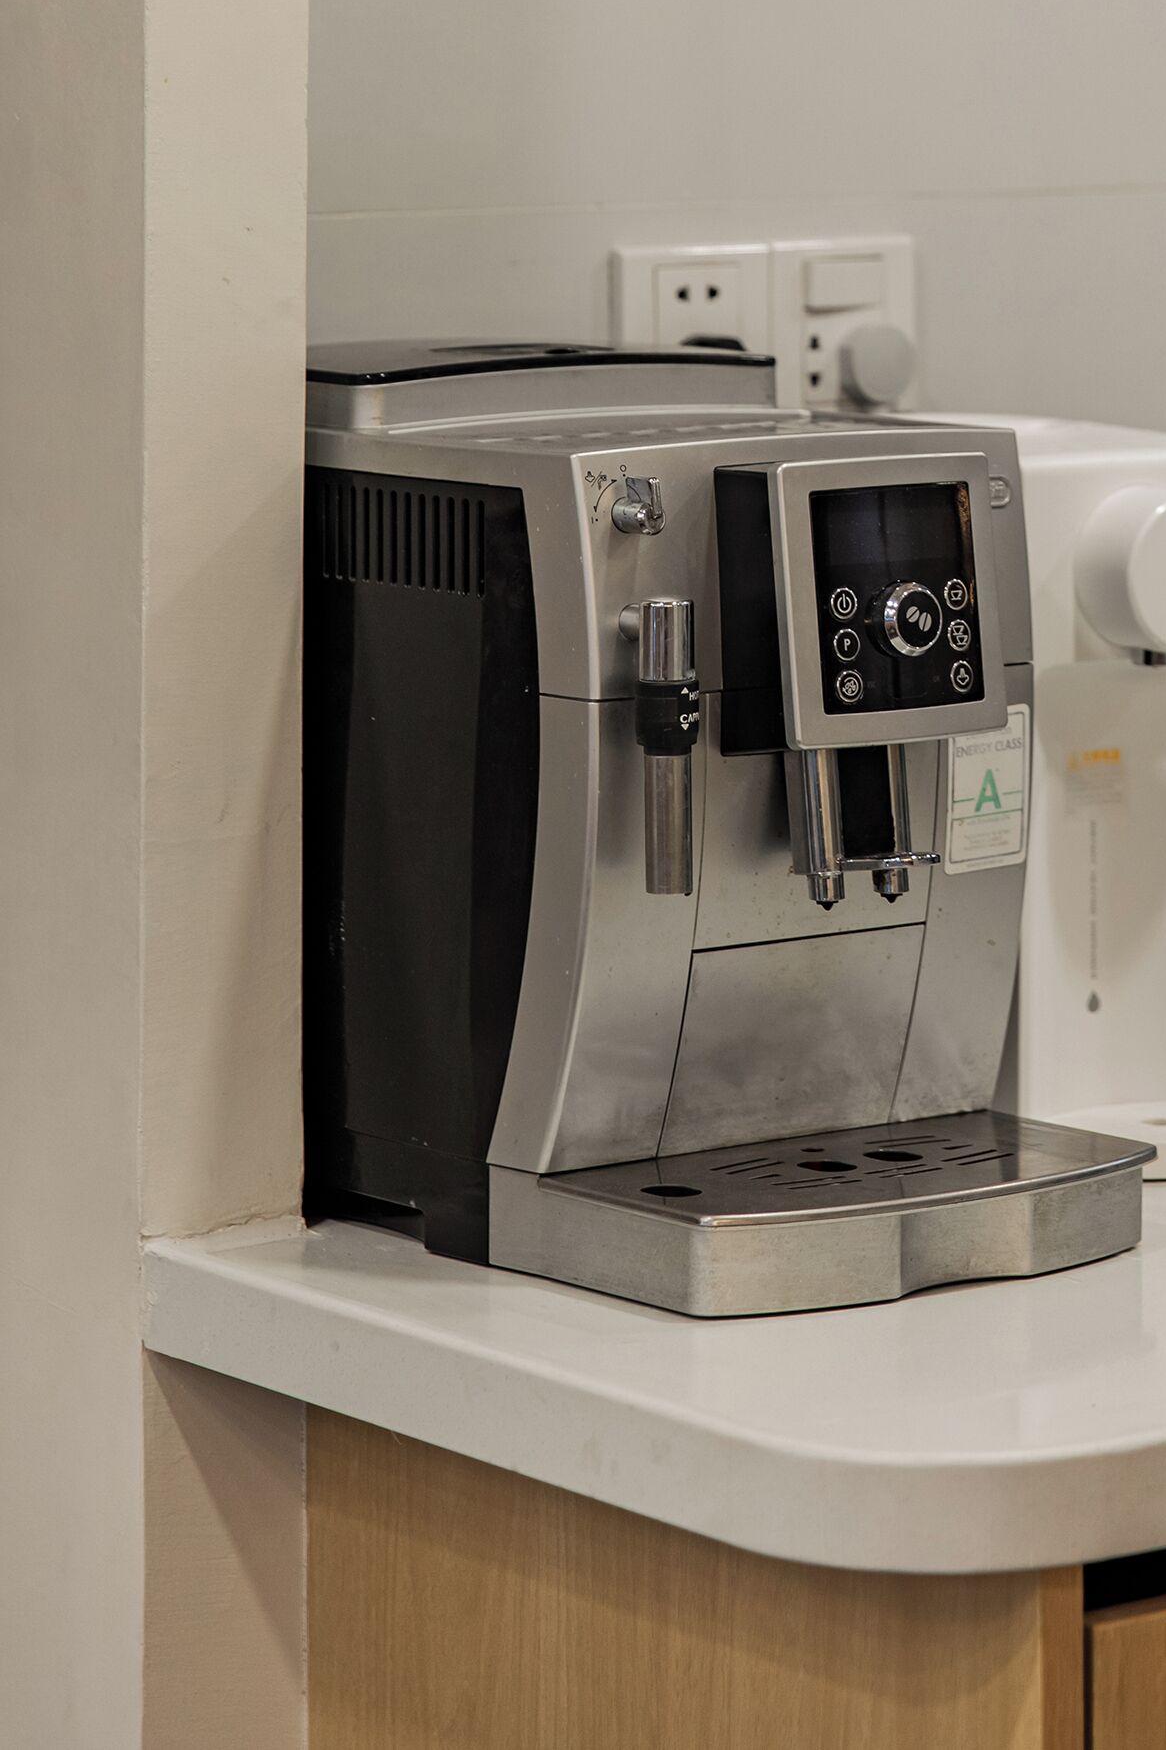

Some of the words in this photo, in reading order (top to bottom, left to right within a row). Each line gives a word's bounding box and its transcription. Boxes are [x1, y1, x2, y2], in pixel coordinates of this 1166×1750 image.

[843, 638, 851, 651] P
[955, 741, 992, 758] ENERGY
[994, 737, 1023, 752] CLASS
[974, 768, 1002, 813] A
